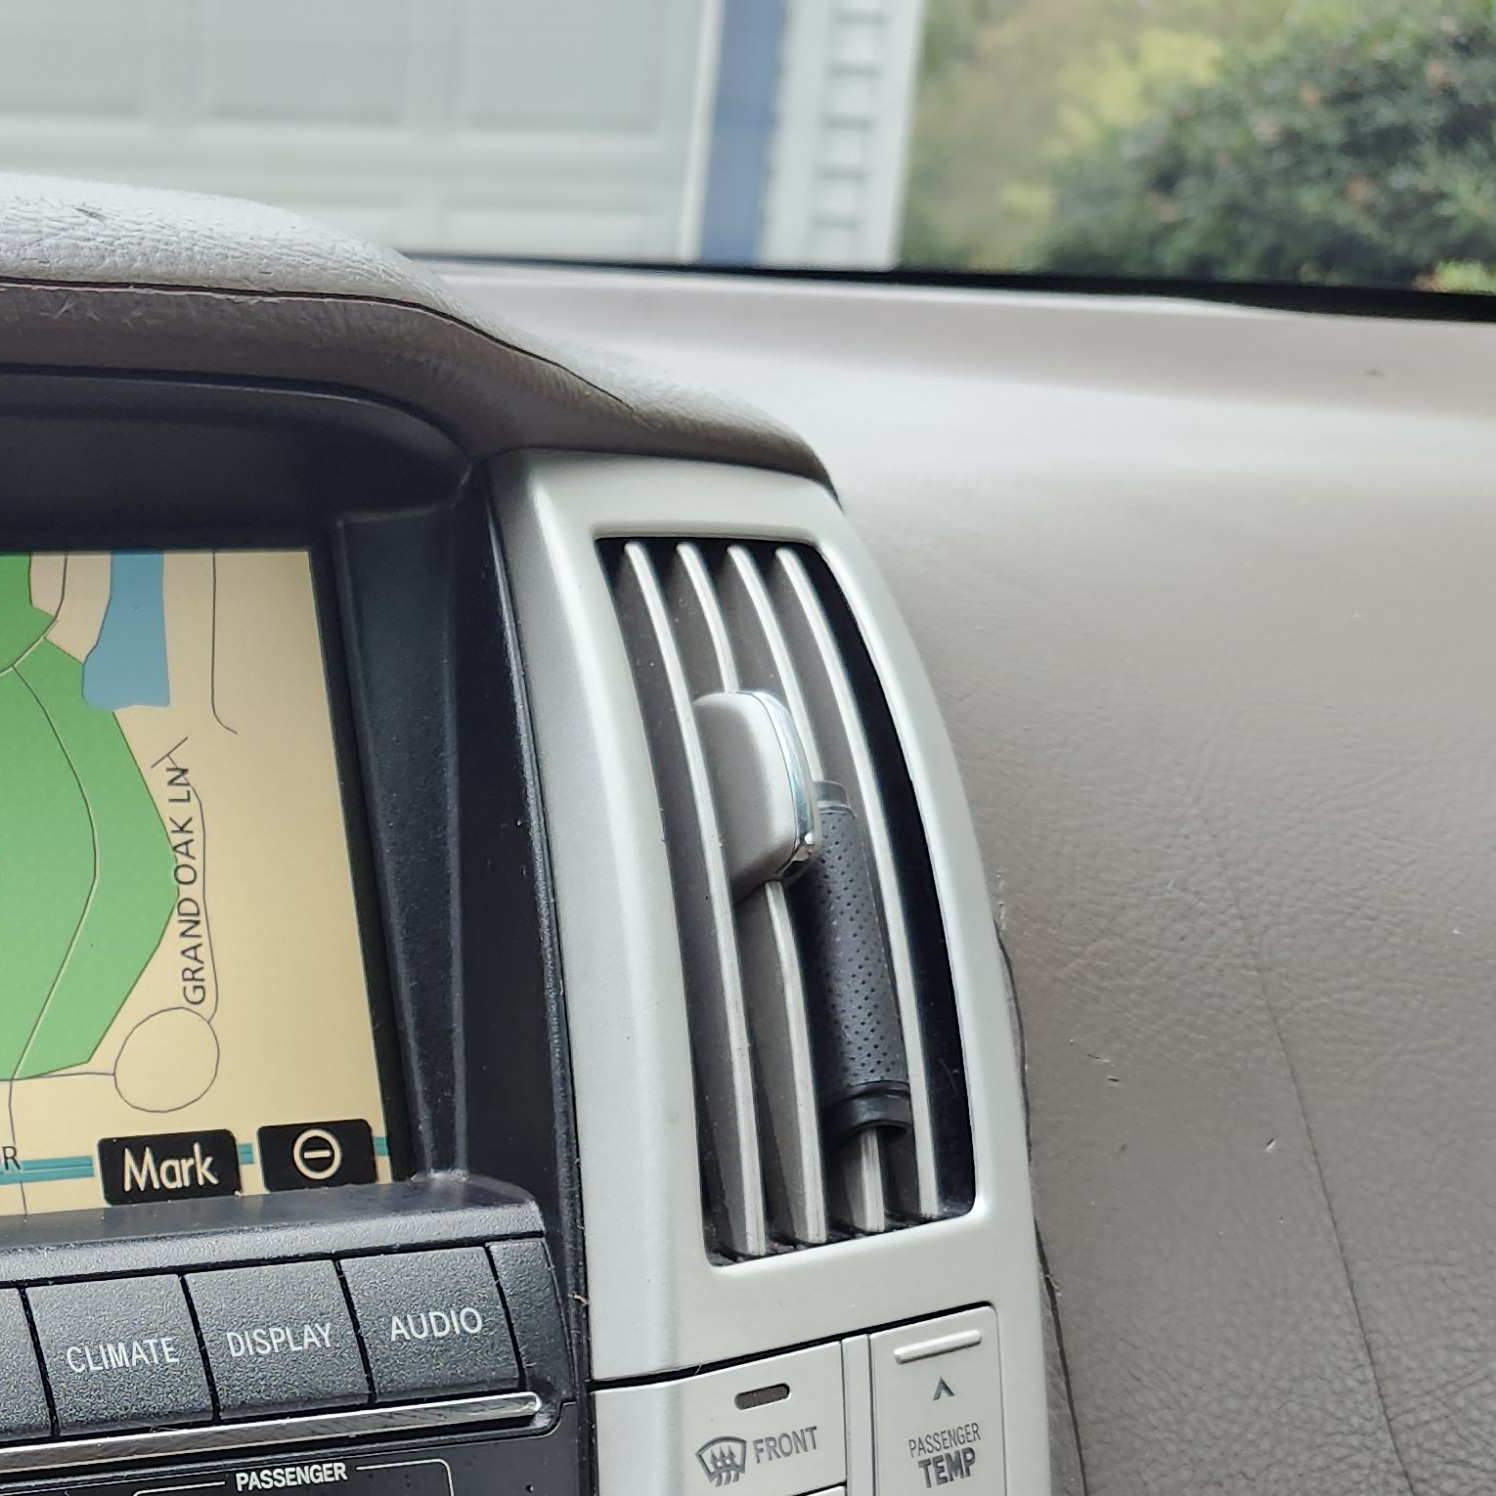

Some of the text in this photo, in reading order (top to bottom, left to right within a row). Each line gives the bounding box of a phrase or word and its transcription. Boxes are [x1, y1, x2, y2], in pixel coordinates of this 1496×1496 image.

[168, 765, 208, 1006] GRAND OAK LN
[122, 1148, 219, 1193] Mark
[226, 1322, 334, 1359] DISPLAY
[388, 1307, 484, 1343] AUDIO
[64, 1337, 180, 1375] CLIMATE
[752, 1426, 818, 1464] FRONT
[908, 1422, 982, 1458] PASSENGER
[235, 1462, 348, 1493] PASSENGER
[917, 1446, 977, 1489] TEMP
